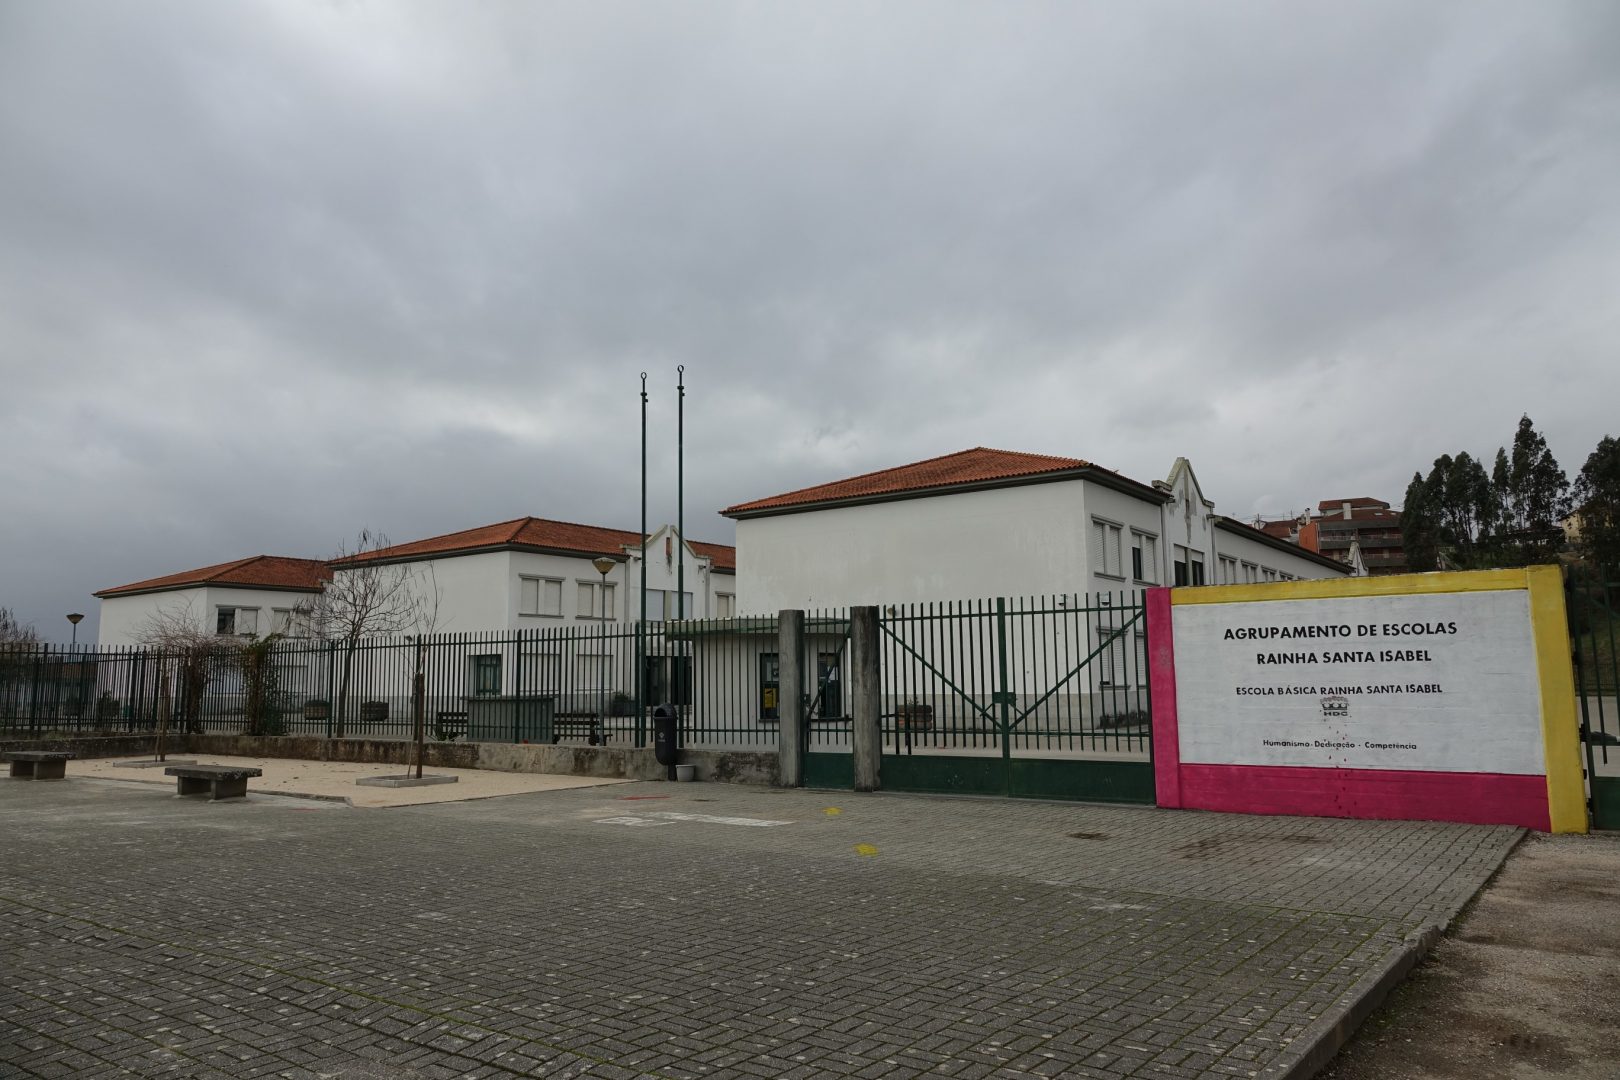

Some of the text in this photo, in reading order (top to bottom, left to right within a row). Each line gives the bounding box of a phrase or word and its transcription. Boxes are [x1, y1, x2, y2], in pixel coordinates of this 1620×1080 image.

[1223, 621, 1458, 640] AGRUPAMENTO DE ESCOLAS
[1256, 650, 1432, 665] RAINHA SANTA ISABEL
[1235, 684, 1443, 696] ESCOLA BÁSICA RAINHA SANTA ISABEL
[1262, 739, 1310, 748] Humanismo
